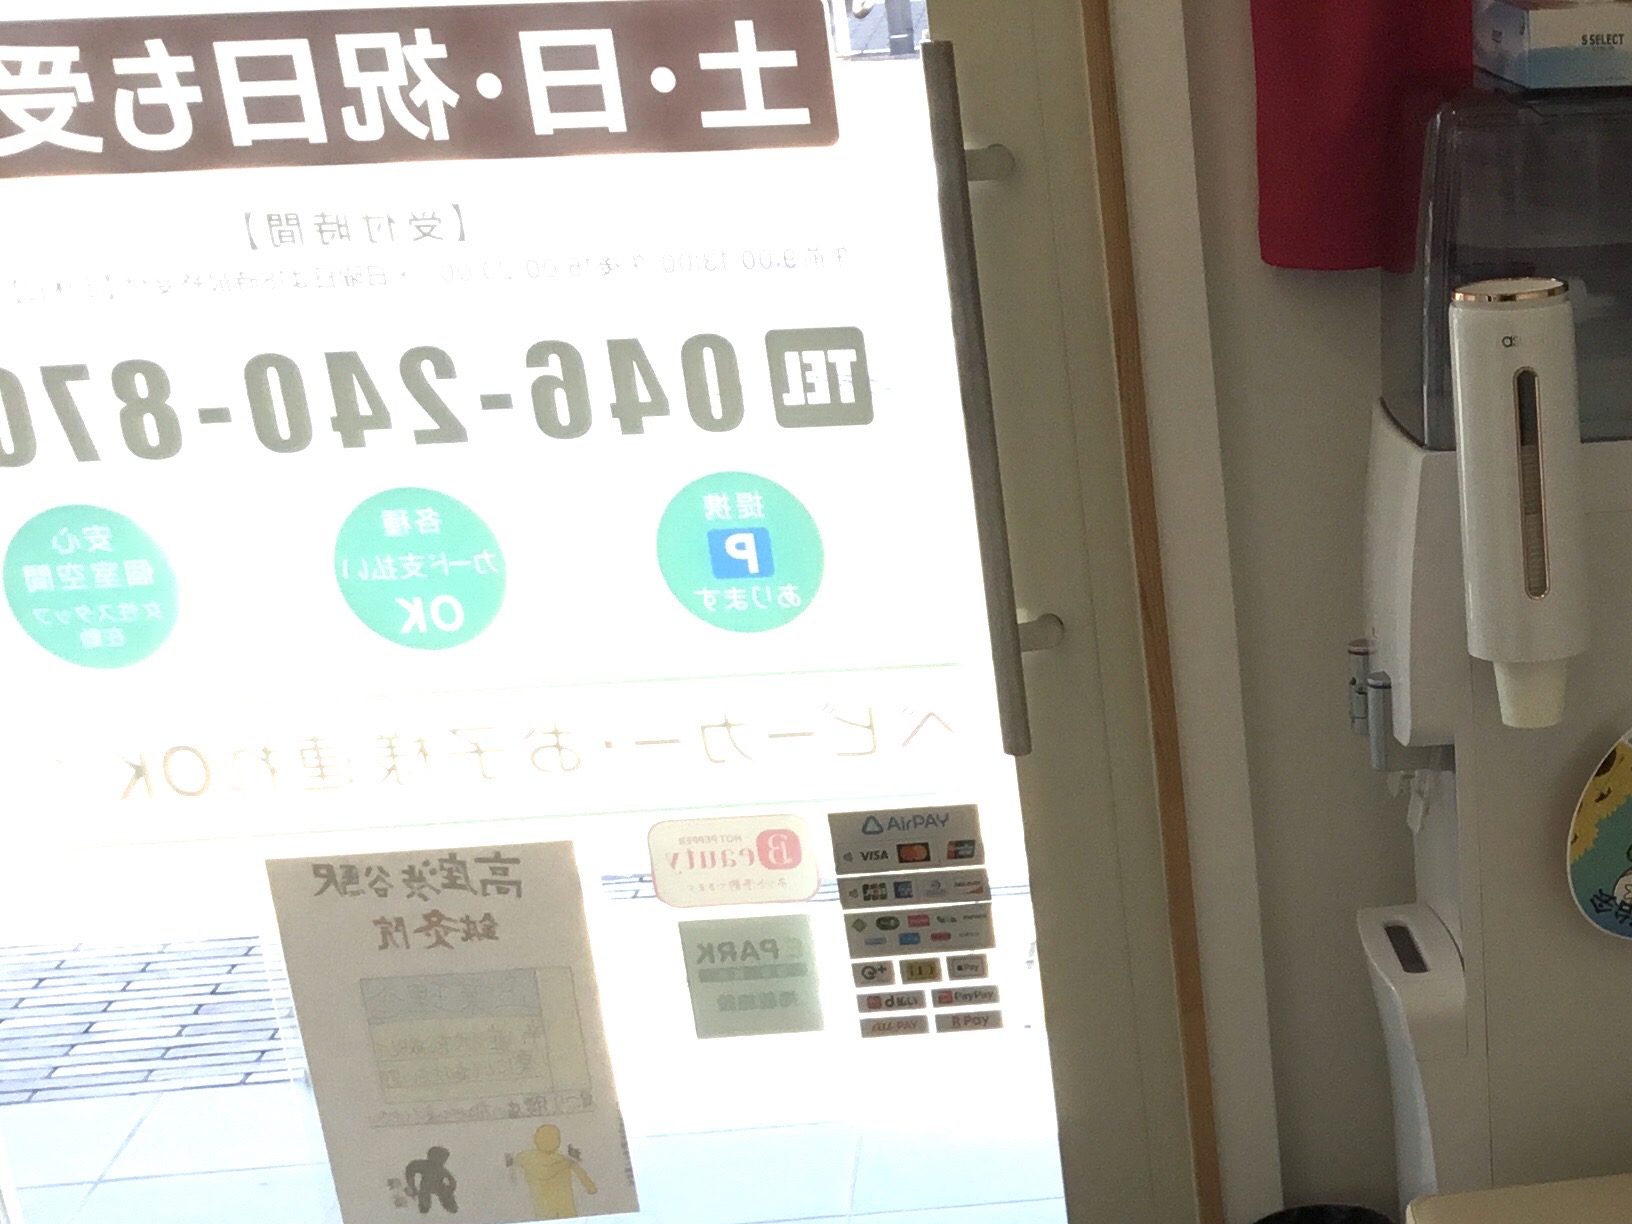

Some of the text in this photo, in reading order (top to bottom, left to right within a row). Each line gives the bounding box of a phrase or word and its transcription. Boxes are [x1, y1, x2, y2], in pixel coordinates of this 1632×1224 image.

[1589, 33, 1625, 45] SELECT
[886, 812, 951, 832] AirPAY
[860, 850, 889, 862] VISA
